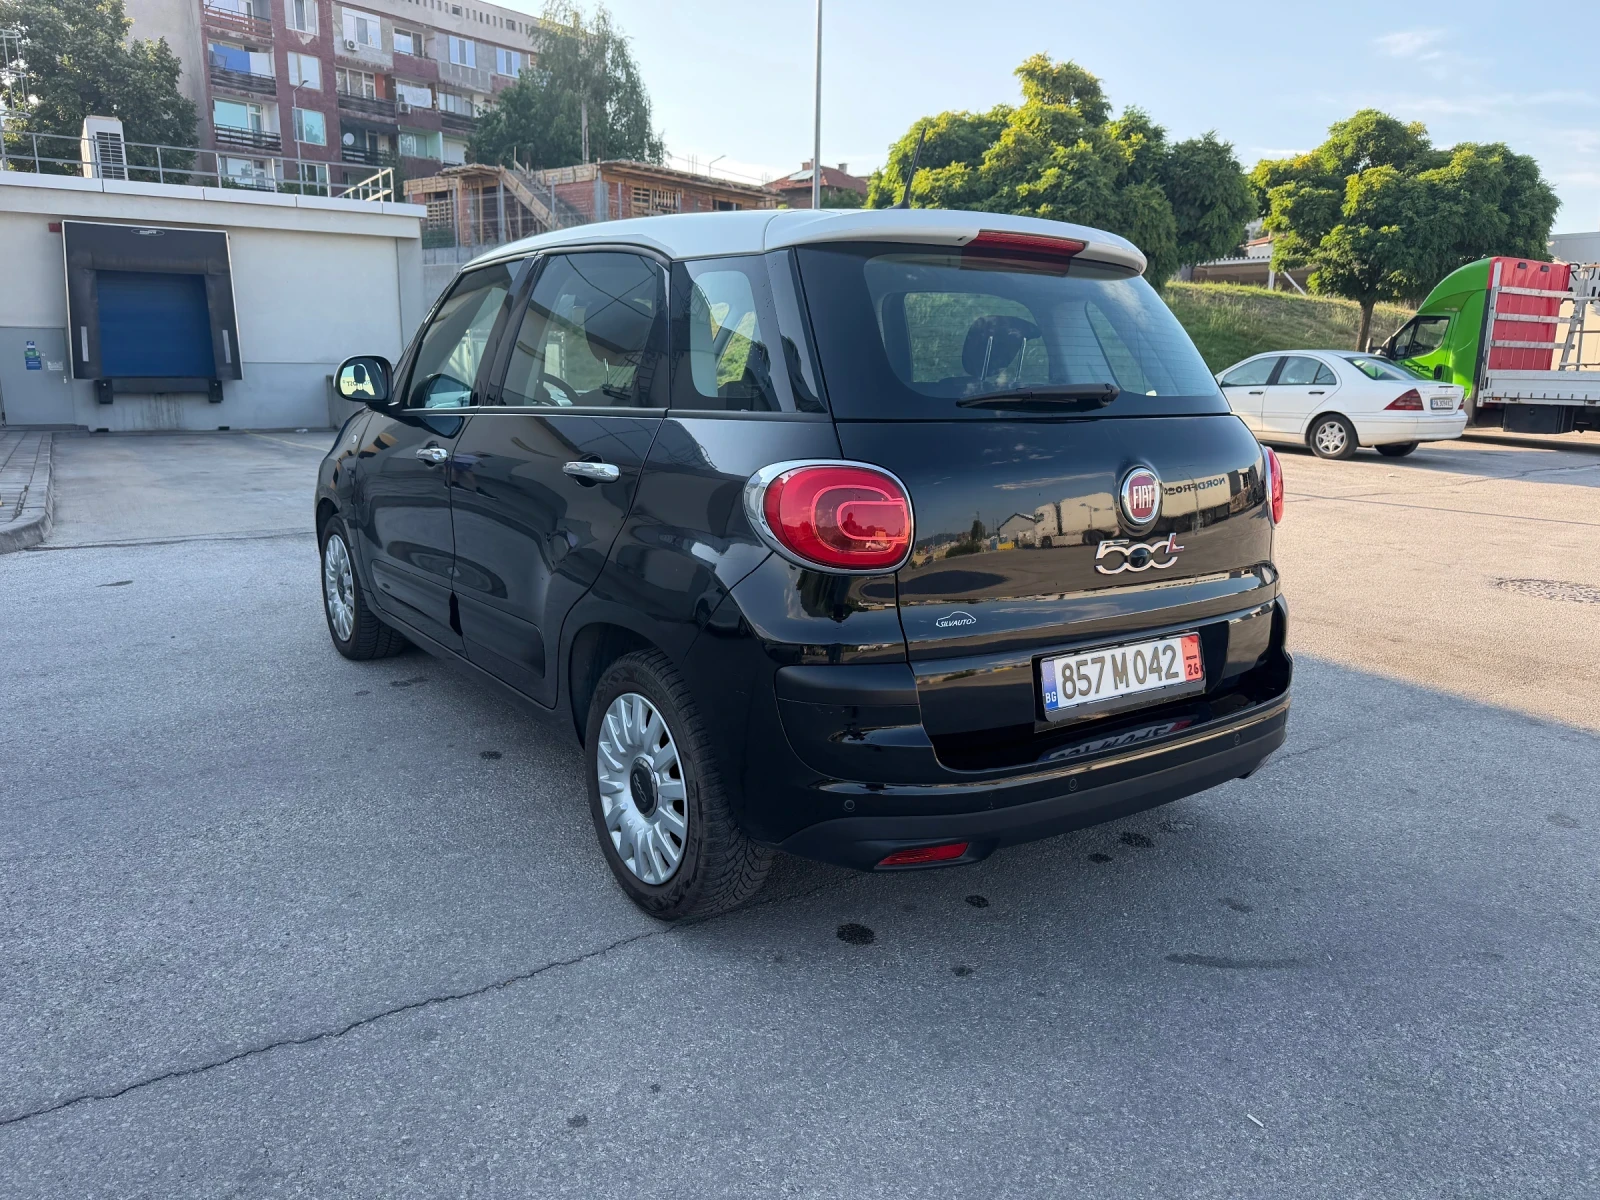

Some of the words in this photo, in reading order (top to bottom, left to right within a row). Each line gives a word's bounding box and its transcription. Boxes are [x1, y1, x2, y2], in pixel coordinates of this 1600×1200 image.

[1132, 484, 1154, 510] FIAT
[940, 618, 973, 628] SILVAUTO
[1187, 663, 1199, 676] 26
[1046, 691, 1057, 704] BG
